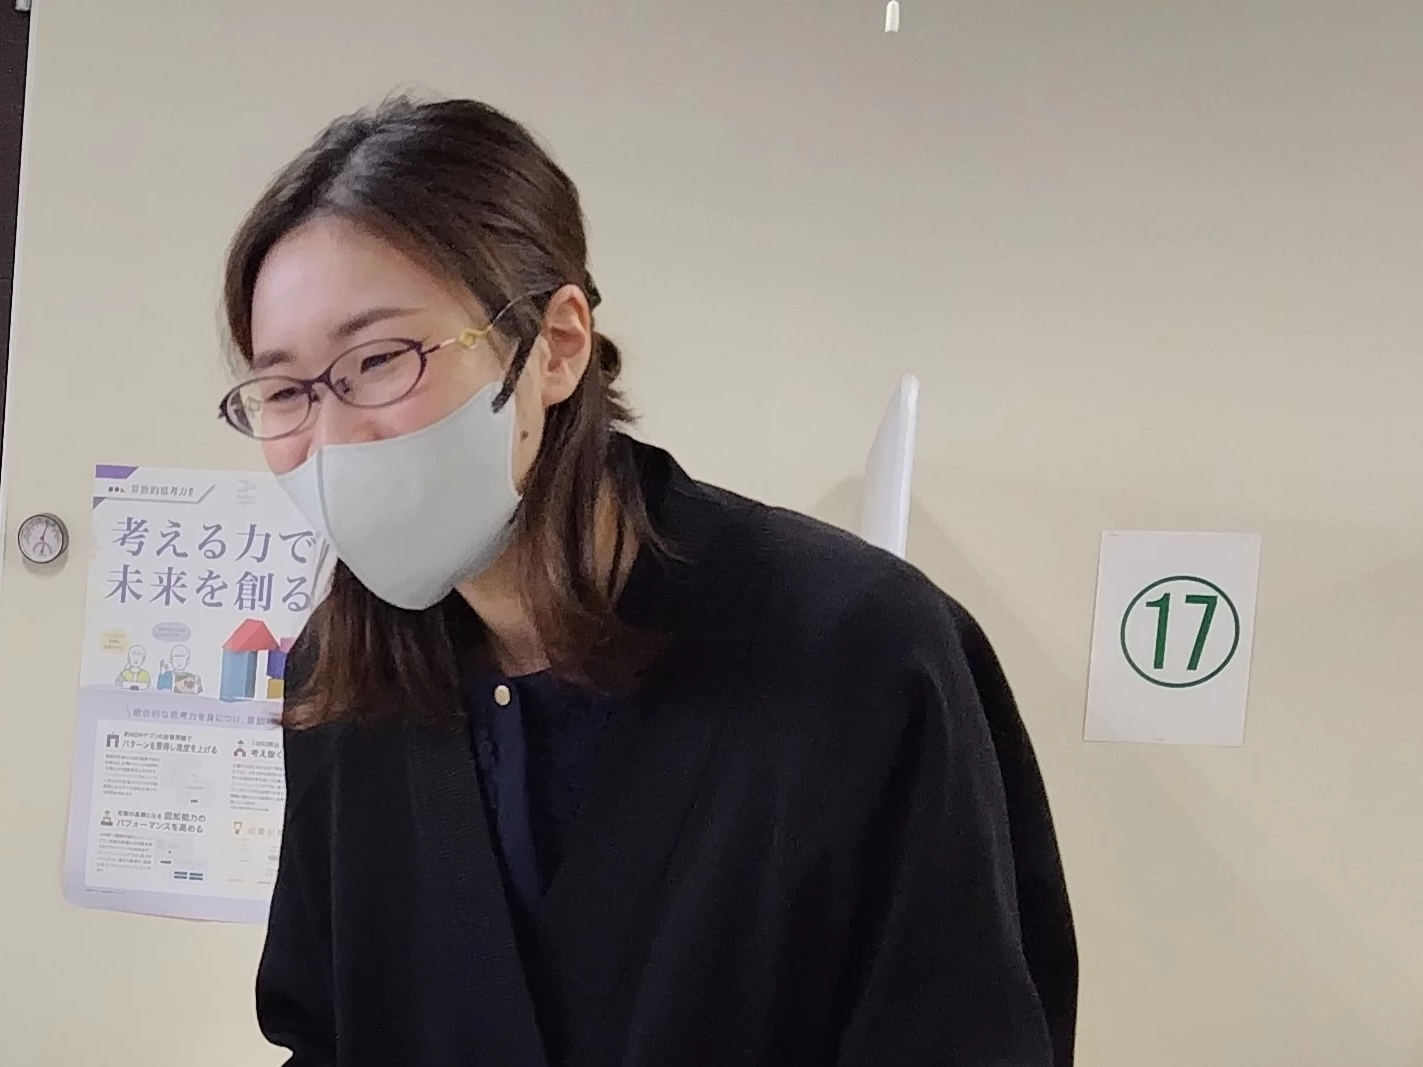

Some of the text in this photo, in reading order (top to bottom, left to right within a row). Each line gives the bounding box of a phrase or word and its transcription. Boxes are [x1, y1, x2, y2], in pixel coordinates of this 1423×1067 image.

[111, 516, 317, 564] 考える力で
[104, 564, 312, 613] 未来を創る
[1145, 592, 1219, 671] 17
